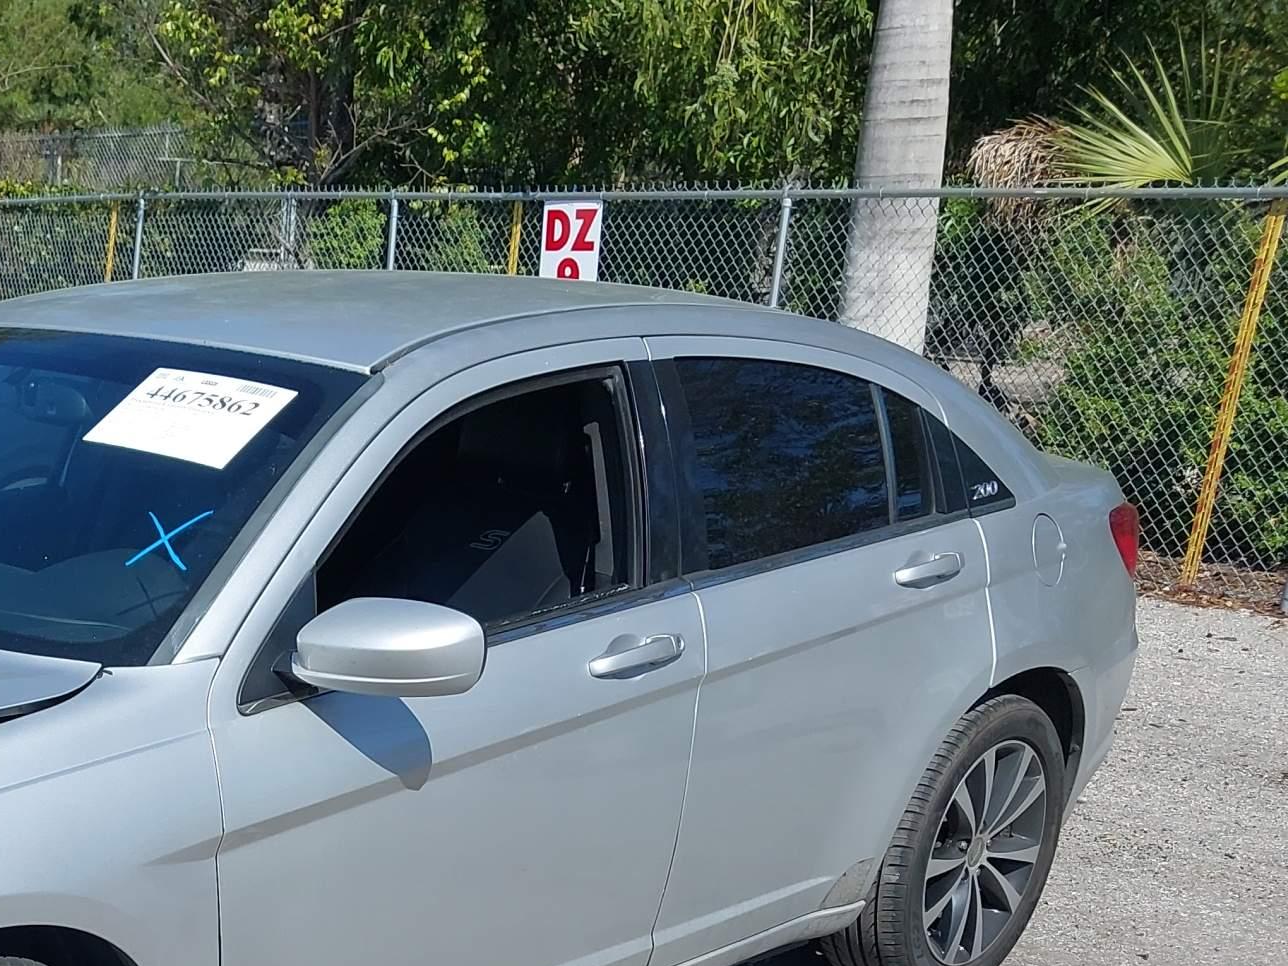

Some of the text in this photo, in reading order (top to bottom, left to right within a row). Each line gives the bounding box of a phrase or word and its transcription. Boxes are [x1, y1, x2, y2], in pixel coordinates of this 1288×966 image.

[545, 208, 599, 251] DZ
[146, 385, 260, 416] 44675862
[971, 480, 999, 500] 200
